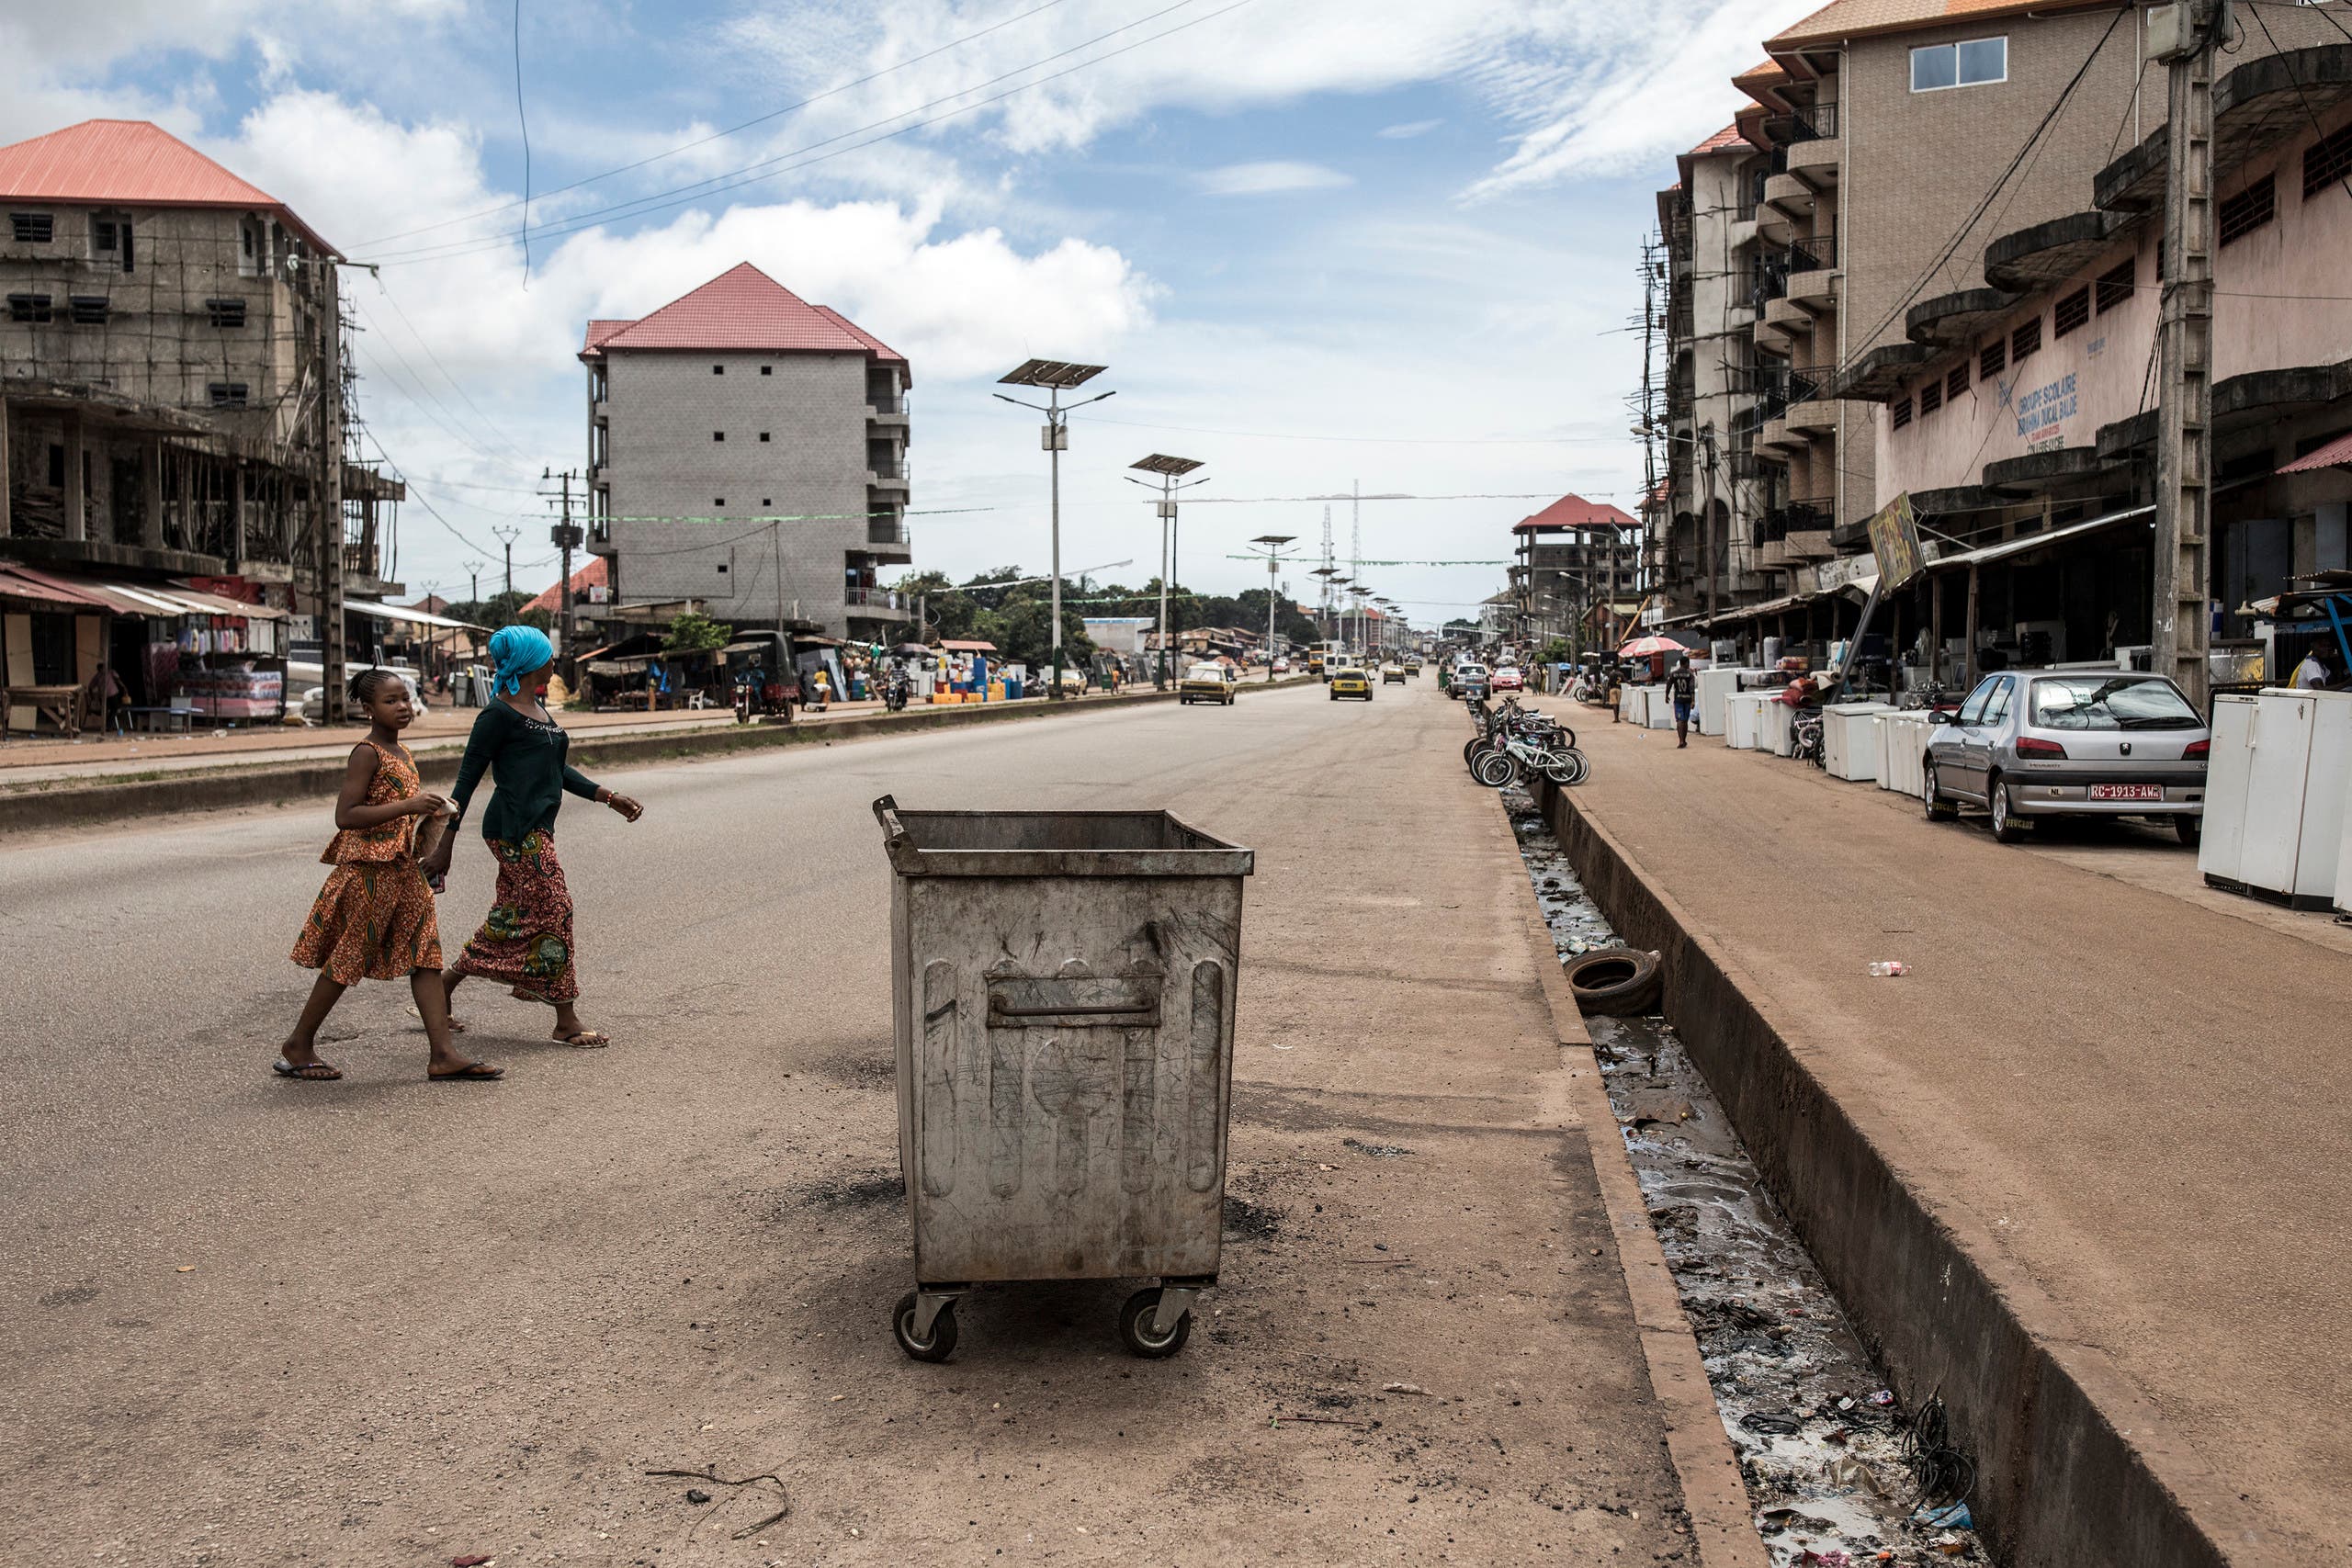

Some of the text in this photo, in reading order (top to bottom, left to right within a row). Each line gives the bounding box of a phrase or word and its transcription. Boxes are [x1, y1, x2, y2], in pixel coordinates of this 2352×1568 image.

[2019, 389, 2041, 416] GROUPE
[2043, 372, 2076, 405] SCOLAIRE
[2060, 395, 2077, 421] BALDE
[1677, 679, 1687, 693] 10
[2091, 785, 2154, 797] RC-1913-AW
